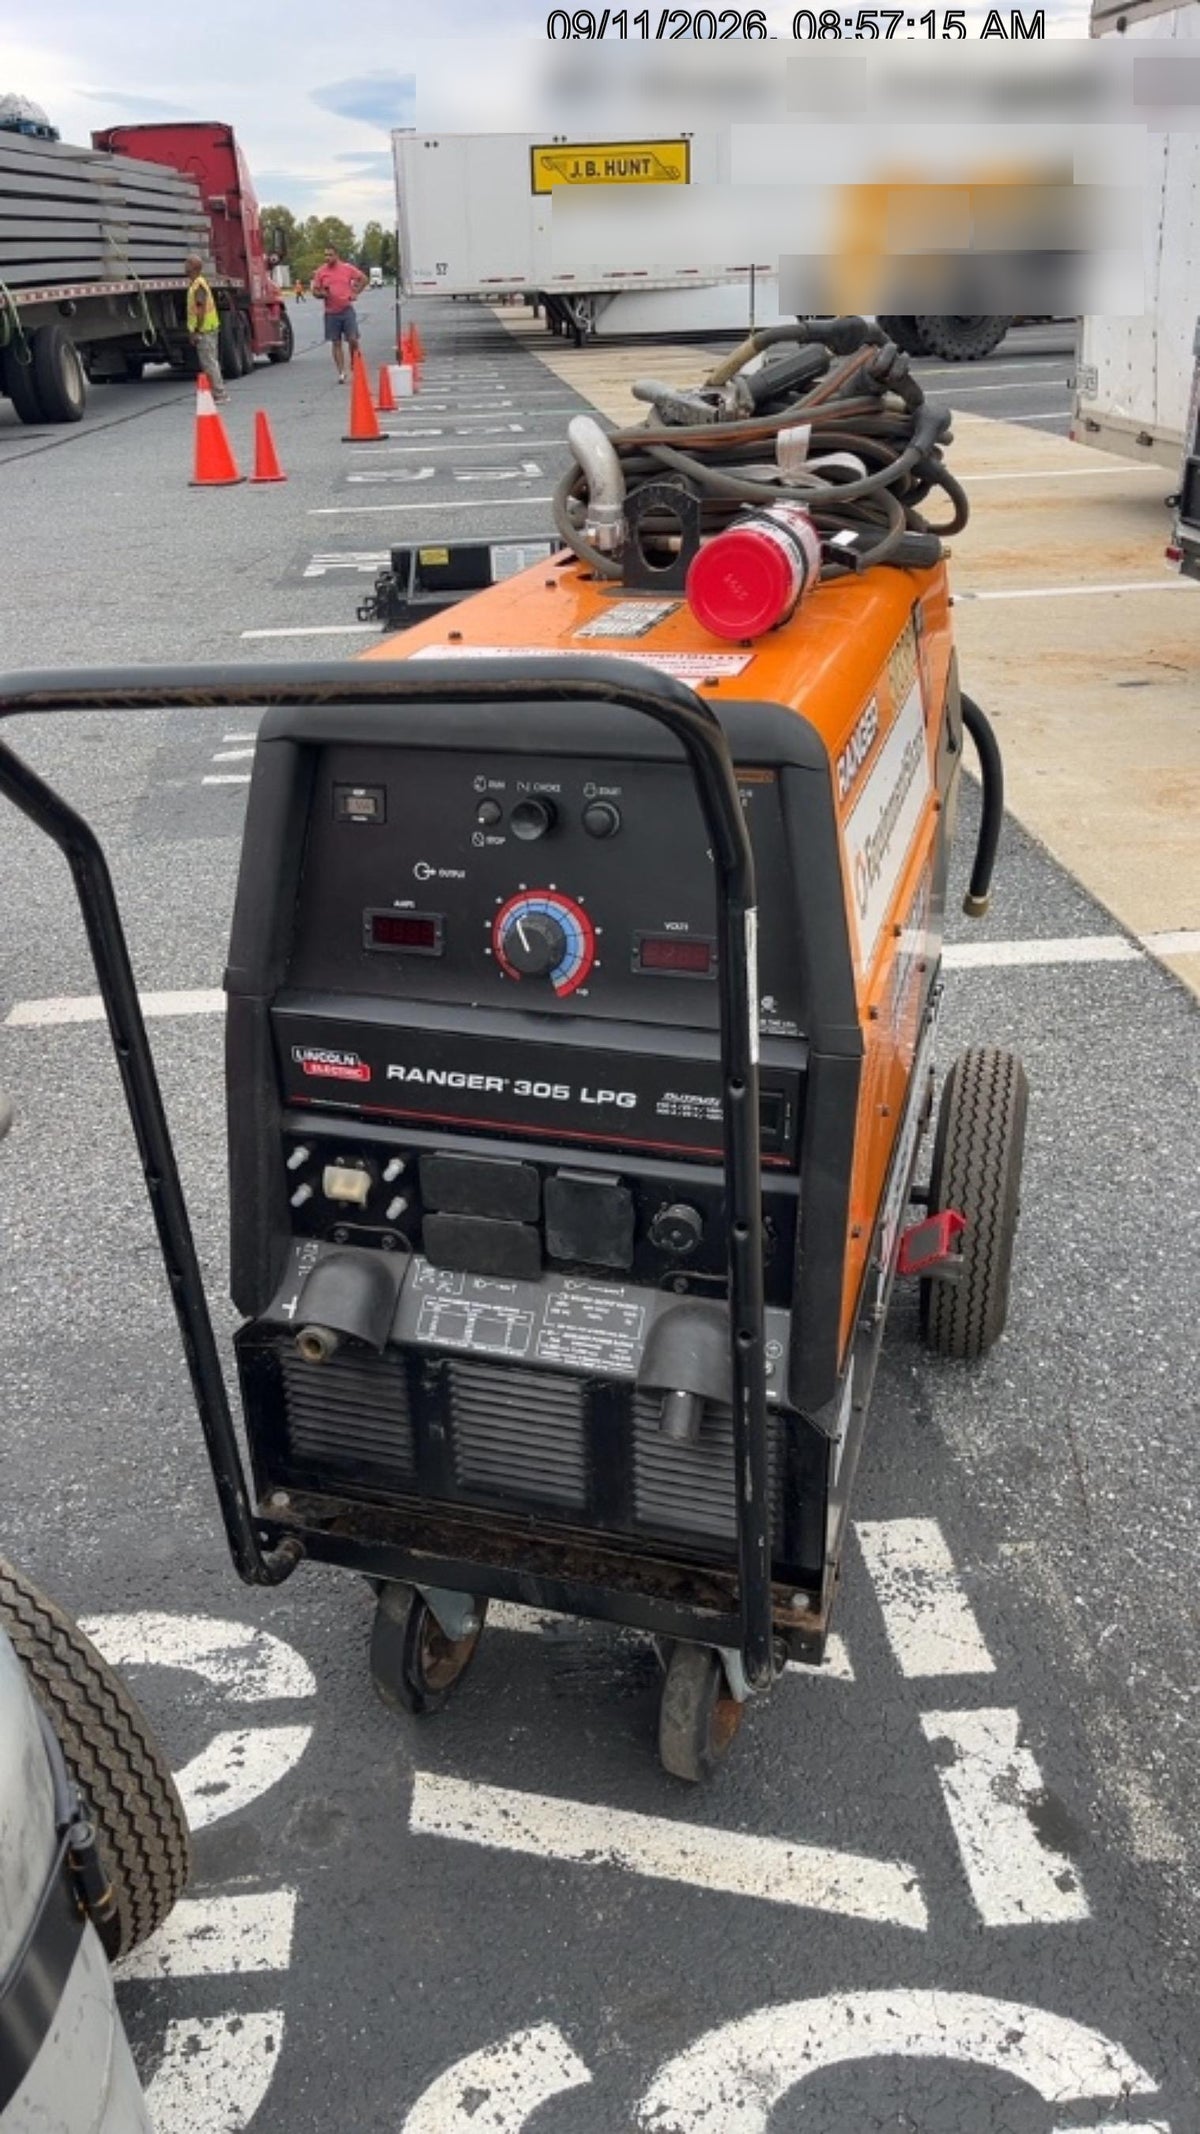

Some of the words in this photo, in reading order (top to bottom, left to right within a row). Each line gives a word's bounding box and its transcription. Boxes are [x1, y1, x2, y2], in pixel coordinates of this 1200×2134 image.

[604, 158, 651, 176] HUNT
[295, 1049, 356, 1065] LINCOLN
[310, 1064, 364, 1079] ELECTRIC
[513, 1079, 571, 1101] 305
[579, 1086, 638, 1109] LPG
